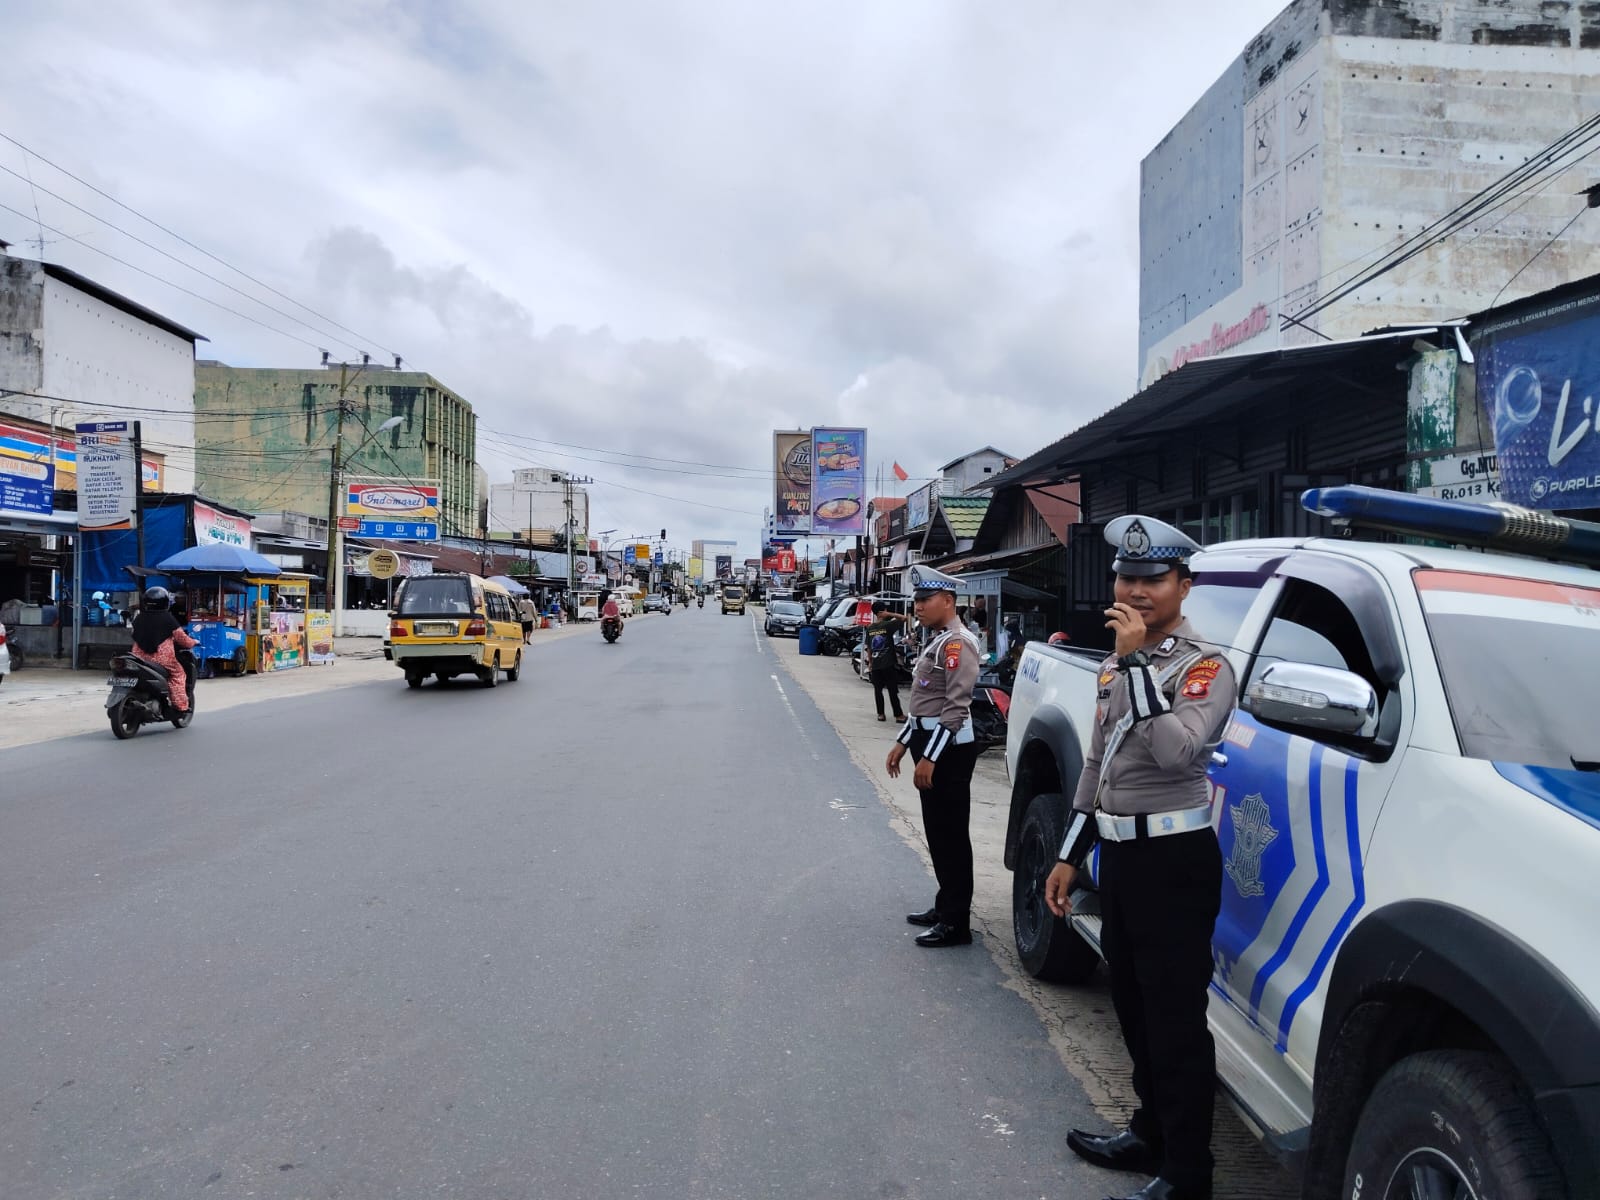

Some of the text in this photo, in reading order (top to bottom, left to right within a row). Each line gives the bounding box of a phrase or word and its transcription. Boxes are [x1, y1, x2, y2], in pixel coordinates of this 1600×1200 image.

[1521, 309, 1547, 324] LAYANAN
[1547, 301, 1577, 316] BERHENTI
[1460, 455, 1499, 479] Gg.MU
[364, 494, 422, 507] Indomaret
